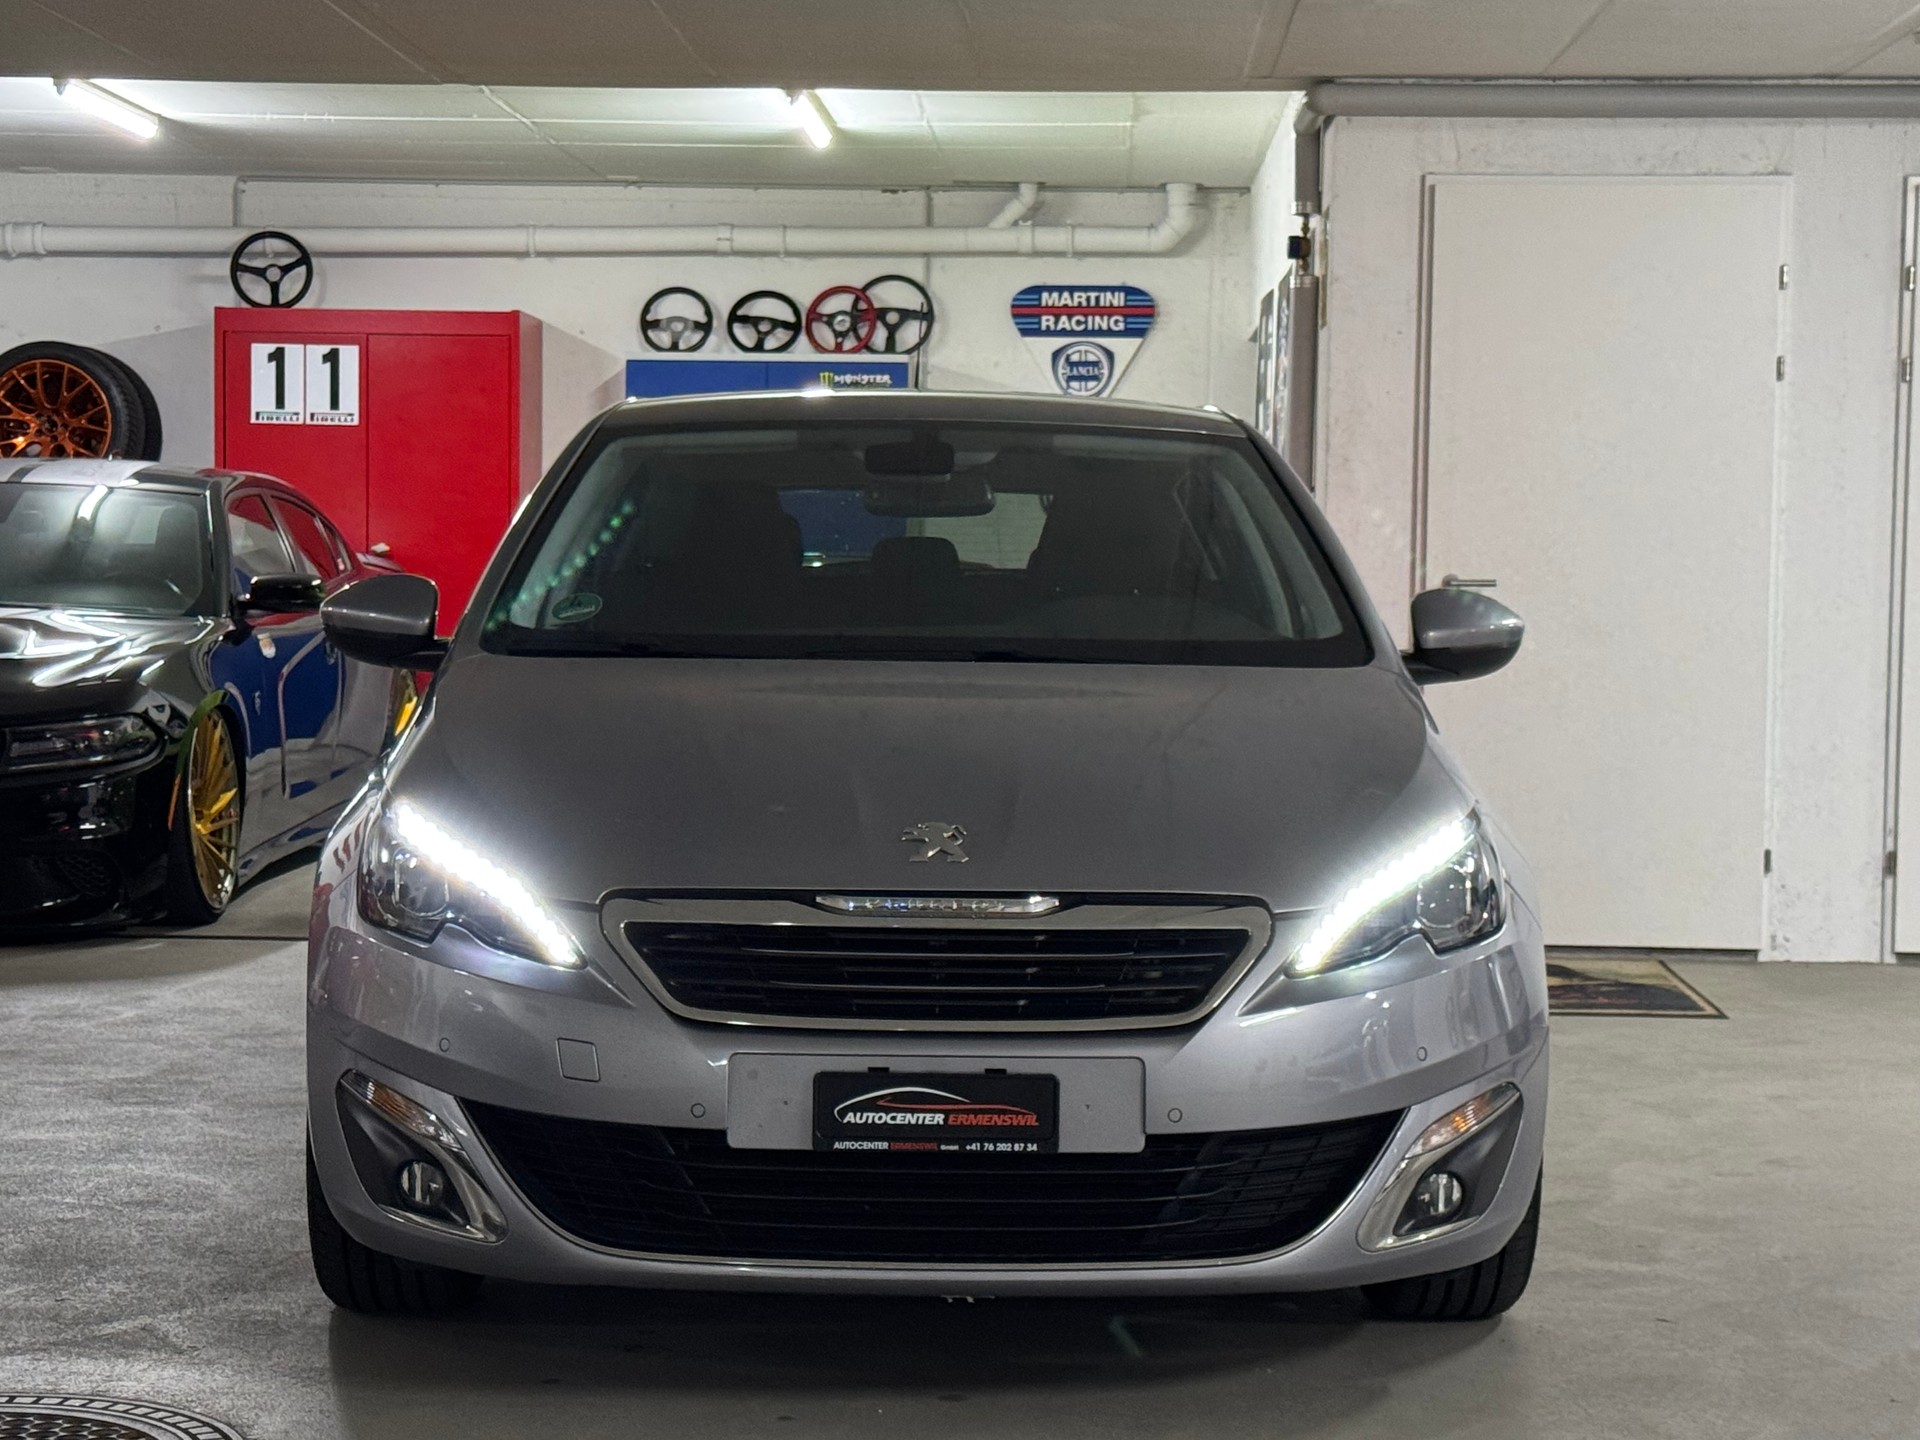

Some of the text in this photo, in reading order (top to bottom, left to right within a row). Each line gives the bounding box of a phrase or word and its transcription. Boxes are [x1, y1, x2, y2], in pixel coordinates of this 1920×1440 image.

[1041, 291, 1126, 307] MARTINI
[1041, 315, 1126, 331] RACING
[1066, 366, 1099, 376] LANCIA
[833, 373, 893, 385] MONSTER
[842, 1112, 1040, 1126] AUTOCENTER ERMENSWIL
[833, 1141, 889, 1150] AUTOCENTER
[965, 1143, 981, 1152] +41
[983, 1143, 995, 1152] 76
[996, 1143, 1012, 1152] 202
[1013, 1143, 1025, 1152] 87
[1026, 1143, 1038, 1152] 34
